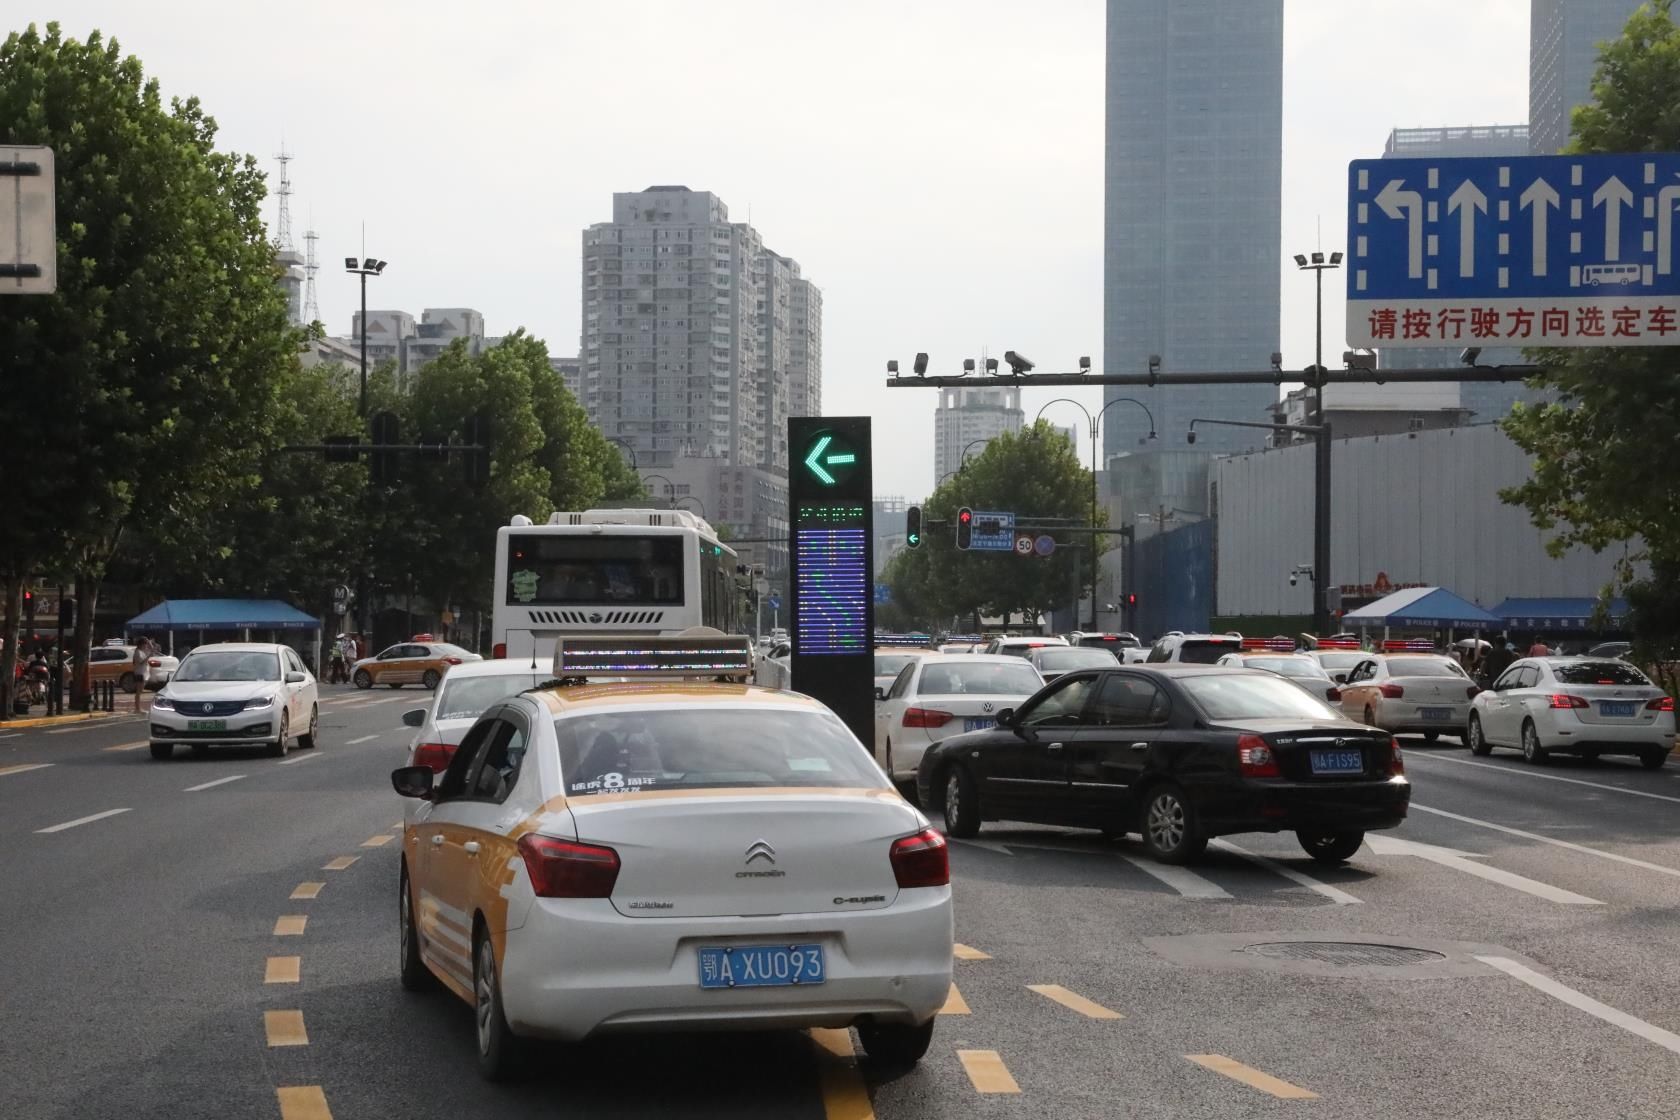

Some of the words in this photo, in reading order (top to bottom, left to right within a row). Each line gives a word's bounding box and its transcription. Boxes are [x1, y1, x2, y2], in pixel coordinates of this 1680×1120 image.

[1368, 305, 1678, 340] 请按行驶方向选定车
[1019, 541, 1031, 550] 50
